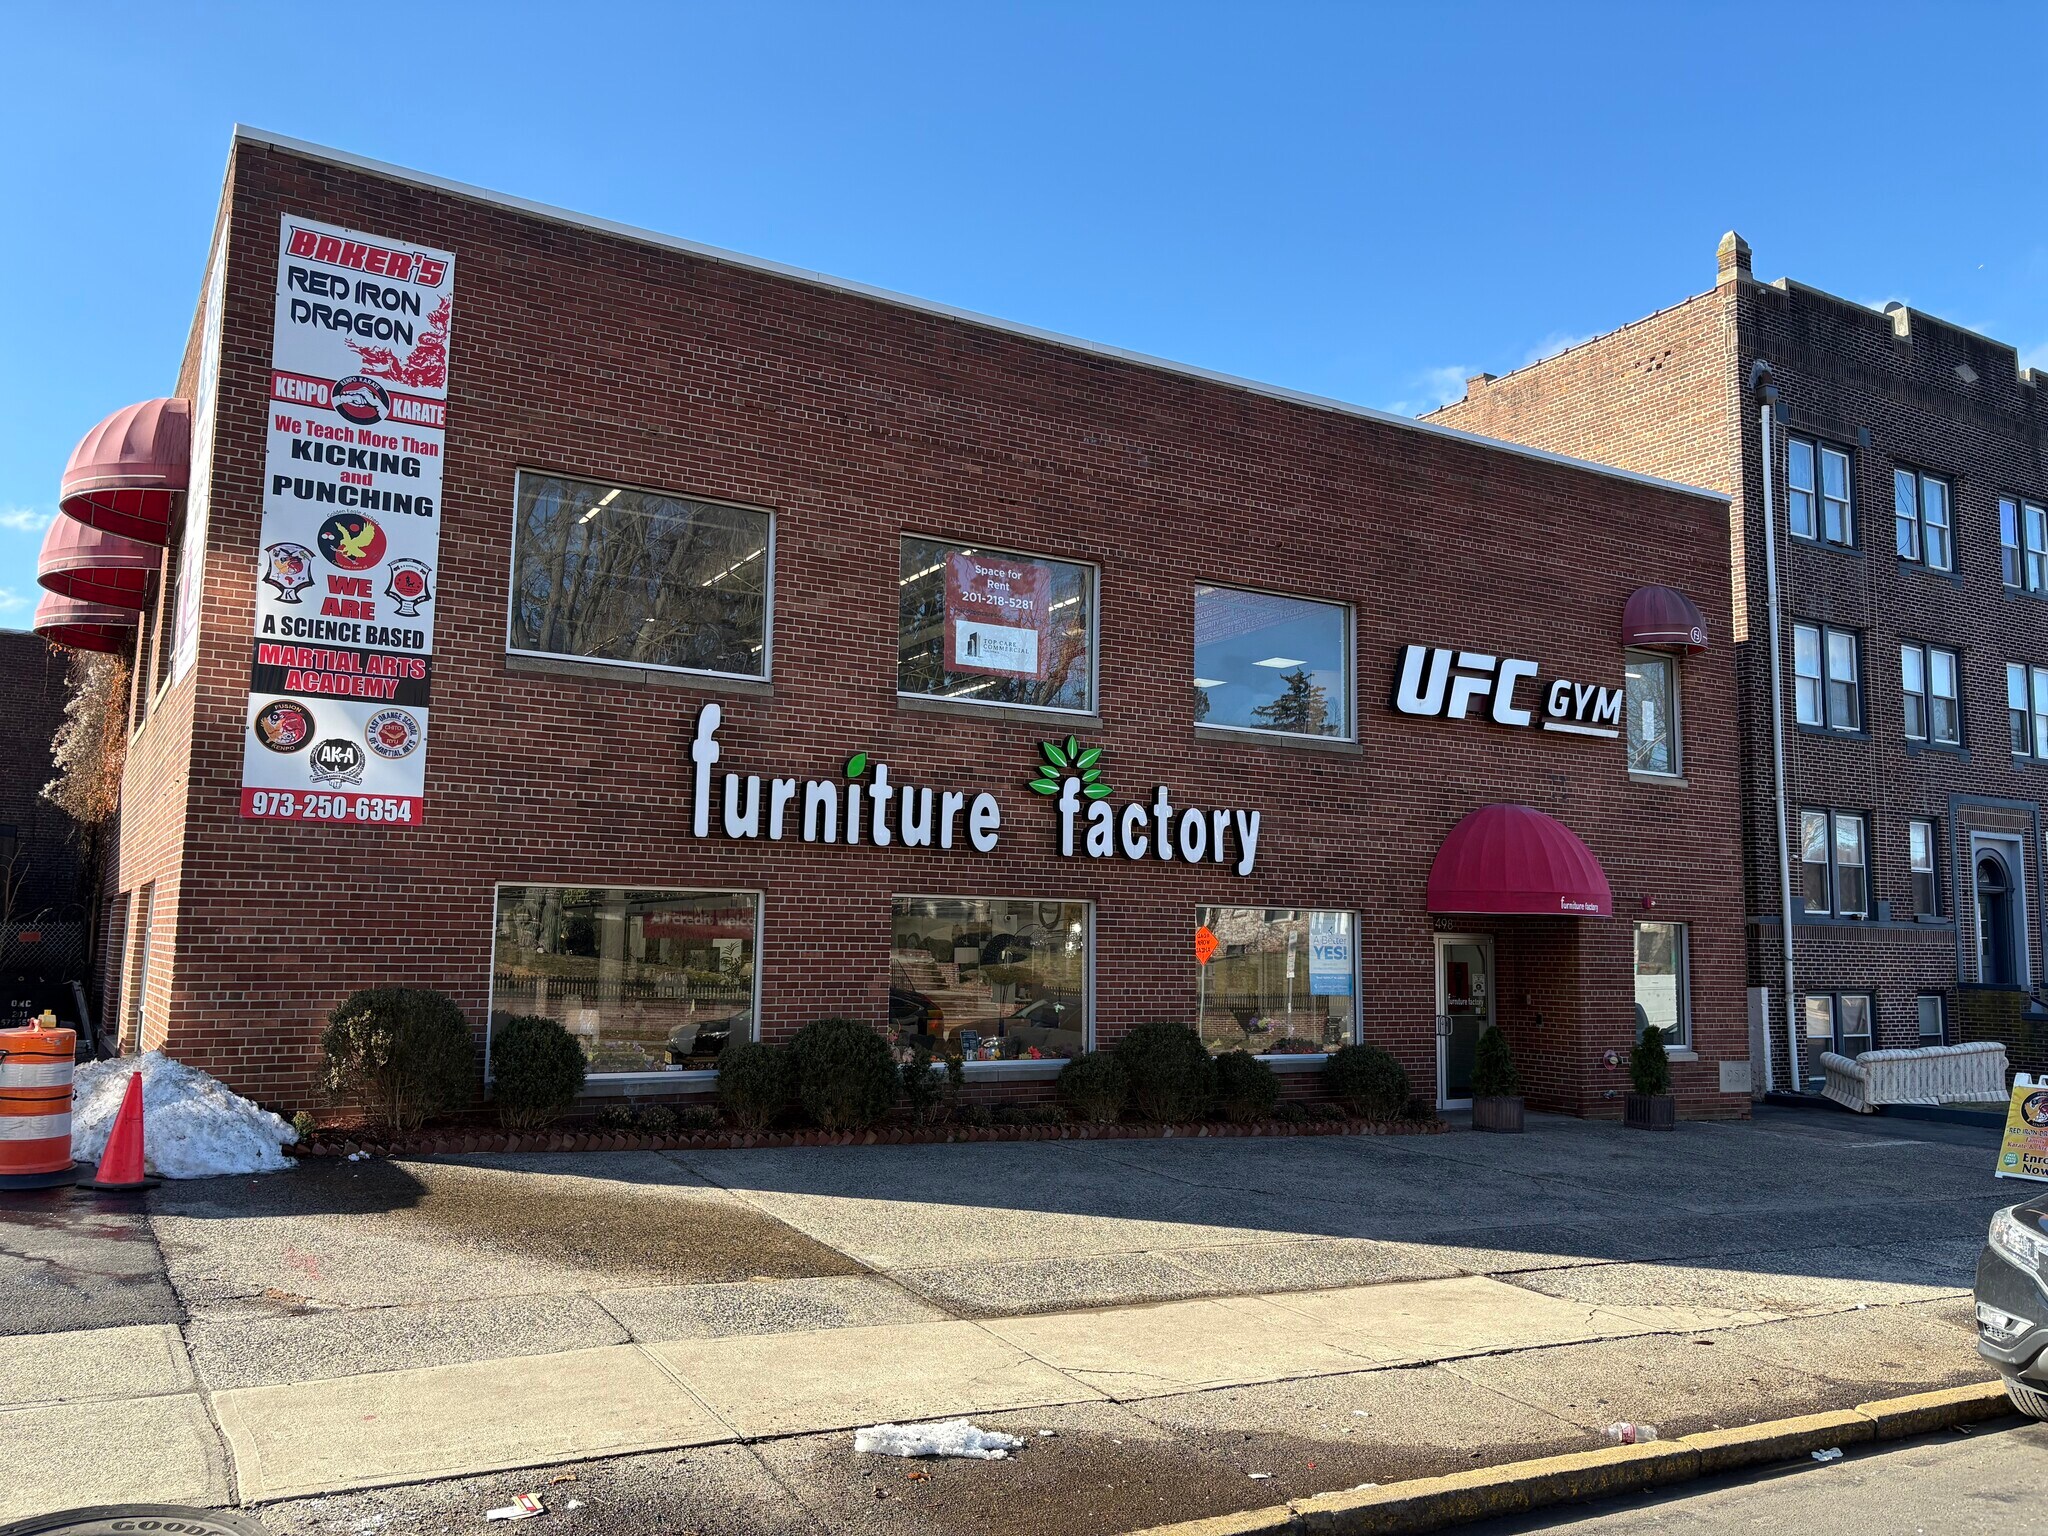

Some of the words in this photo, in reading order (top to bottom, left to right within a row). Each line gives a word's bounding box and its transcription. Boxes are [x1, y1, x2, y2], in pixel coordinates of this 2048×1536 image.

[288, 227, 447, 287] BAKER'S
[288, 266, 350, 300] RED
[355, 280, 420, 317] IRON
[291, 298, 413, 346] DRAGON
[276, 376, 328, 404] KENPO
[392, 399, 445, 425] KARATE
[275, 415, 302, 434] We
[306, 420, 354, 443] Teach
[358, 430, 398, 450] More
[402, 436, 438, 456] Than
[292, 438, 421, 478] KICKING
[340, 470, 372, 486] and
[272, 474, 434, 518] PUNCHING
[976, 565, 1006, 578] Space
[1008, 569, 1022, 580] for
[327, 574, 372, 598] WE
[987, 580, 1010, 591] Rent
[320, 597, 375, 620] ARE
[962, 592, 1033, 610] 201-218-5281
[262, 614, 276, 634] A
[281, 616, 361, 643] SCIENCE
[366, 626, 424, 650] BASED
[258, 643, 362, 674] MARTIAL
[366, 654, 426, 679] ARTS
[983, 644, 1030, 654] COMMERCIAL
[284, 670, 399, 699] ACADEMY
[1396, 645, 1539, 727] UFC
[1547, 679, 1623, 726] GYM
[274, 704, 302, 713] FUSION
[369, 719, 380, 734] EAST
[378, 712, 402, 722] ORANGE
[402, 716, 418, 736] SCHOOL
[374, 744, 402, 757] MARTIAL
[402, 740, 416, 754] ARTS
[691, 703, 1001, 853] furniture
[1058, 776, 1261, 877] factory
[252, 791, 412, 822] 973-250-6354
[1560, 896, 1584, 910] furniture
[672, 914, 714, 926] credit
[1435, 918, 1454, 930] 498
[1314, 936, 1320, 944] A
[1322, 936, 1347, 944] Better
[1314, 946, 1348, 960] YES!
